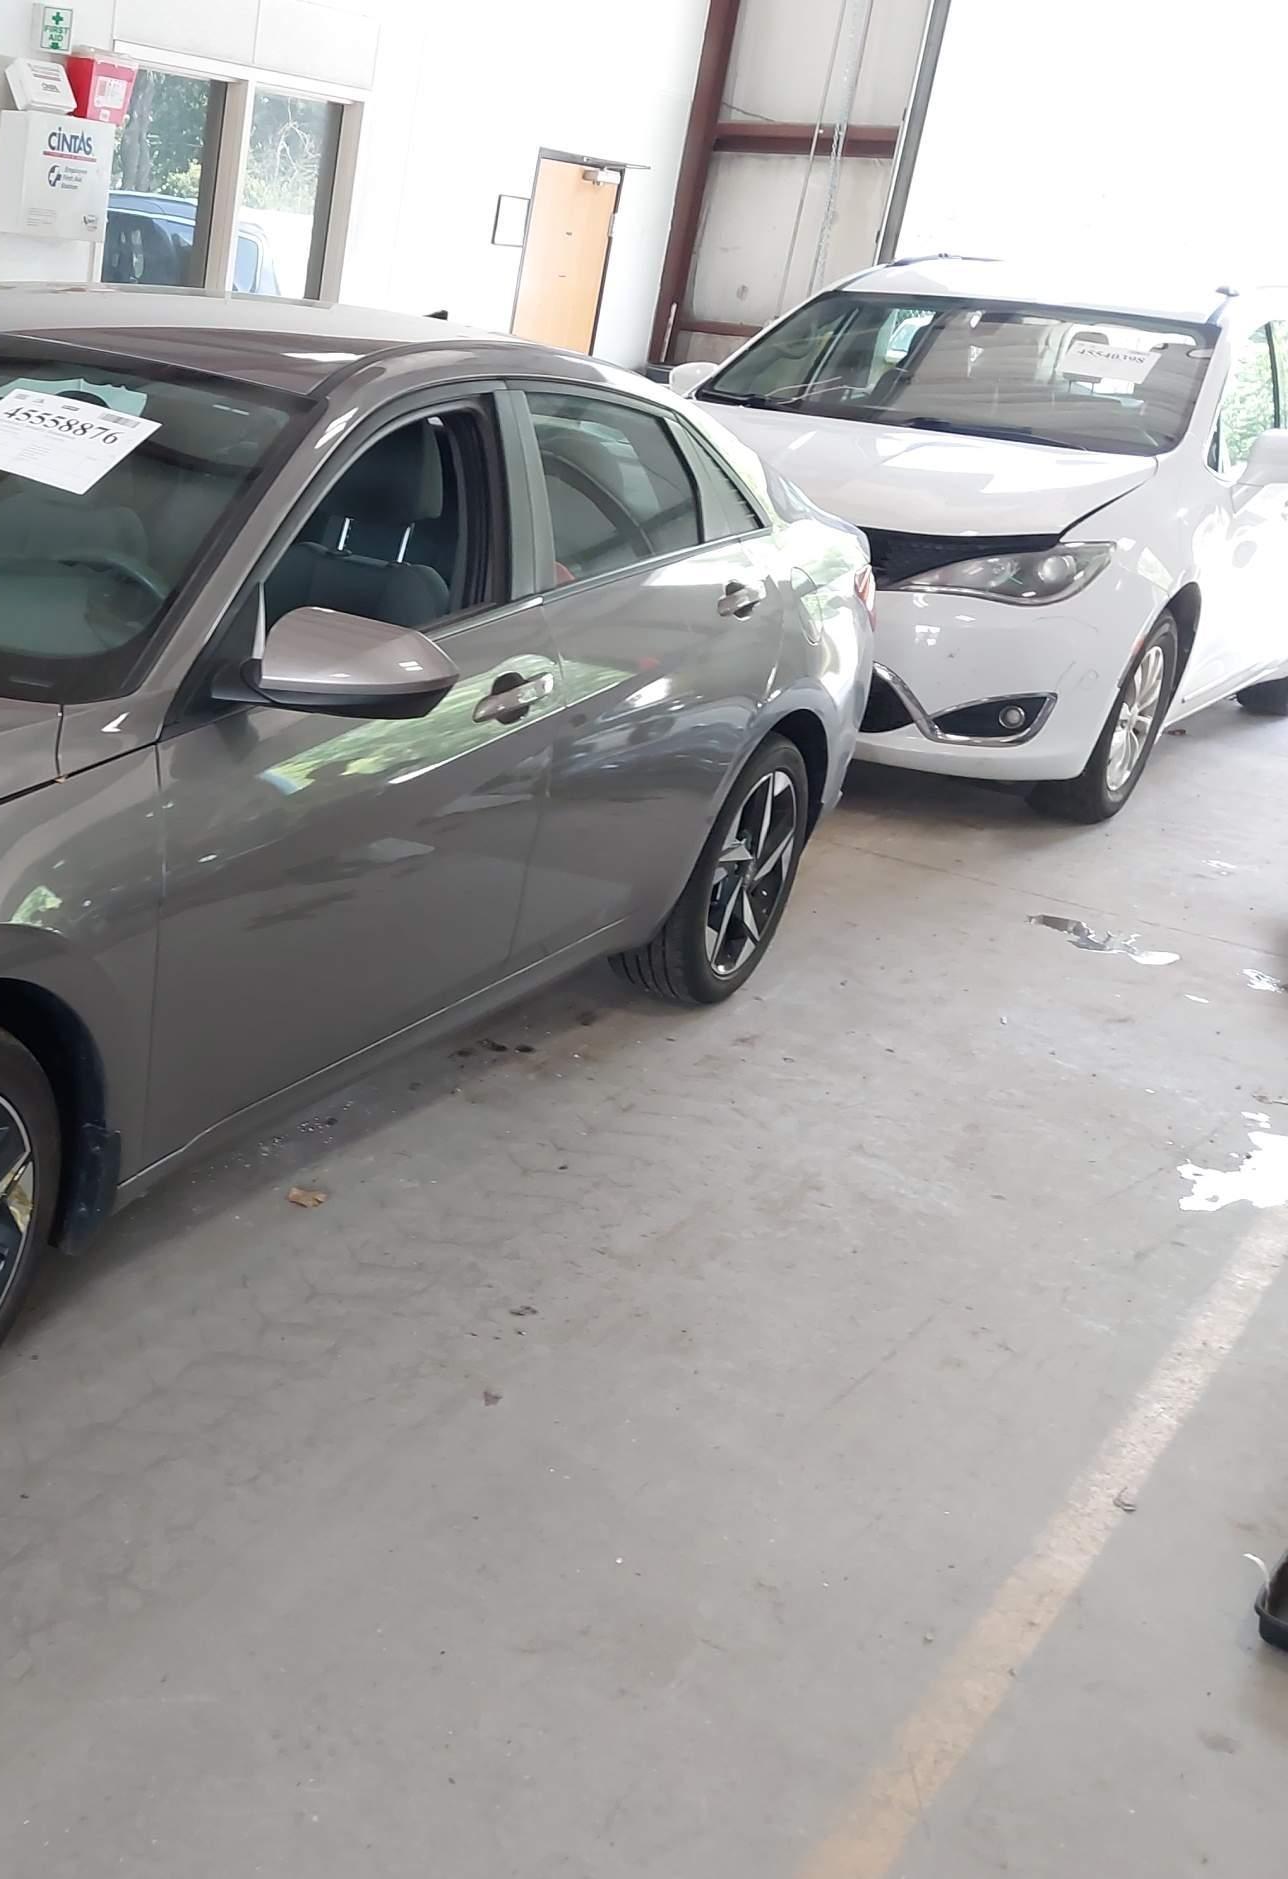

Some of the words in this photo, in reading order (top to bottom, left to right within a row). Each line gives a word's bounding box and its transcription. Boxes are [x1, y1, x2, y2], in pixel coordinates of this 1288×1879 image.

[44, 25, 68, 34] FIRST
[48, 34, 63, 42] AID
[48, 126, 92, 155] CINTAS
[3, 407, 121, 445] 45558876
